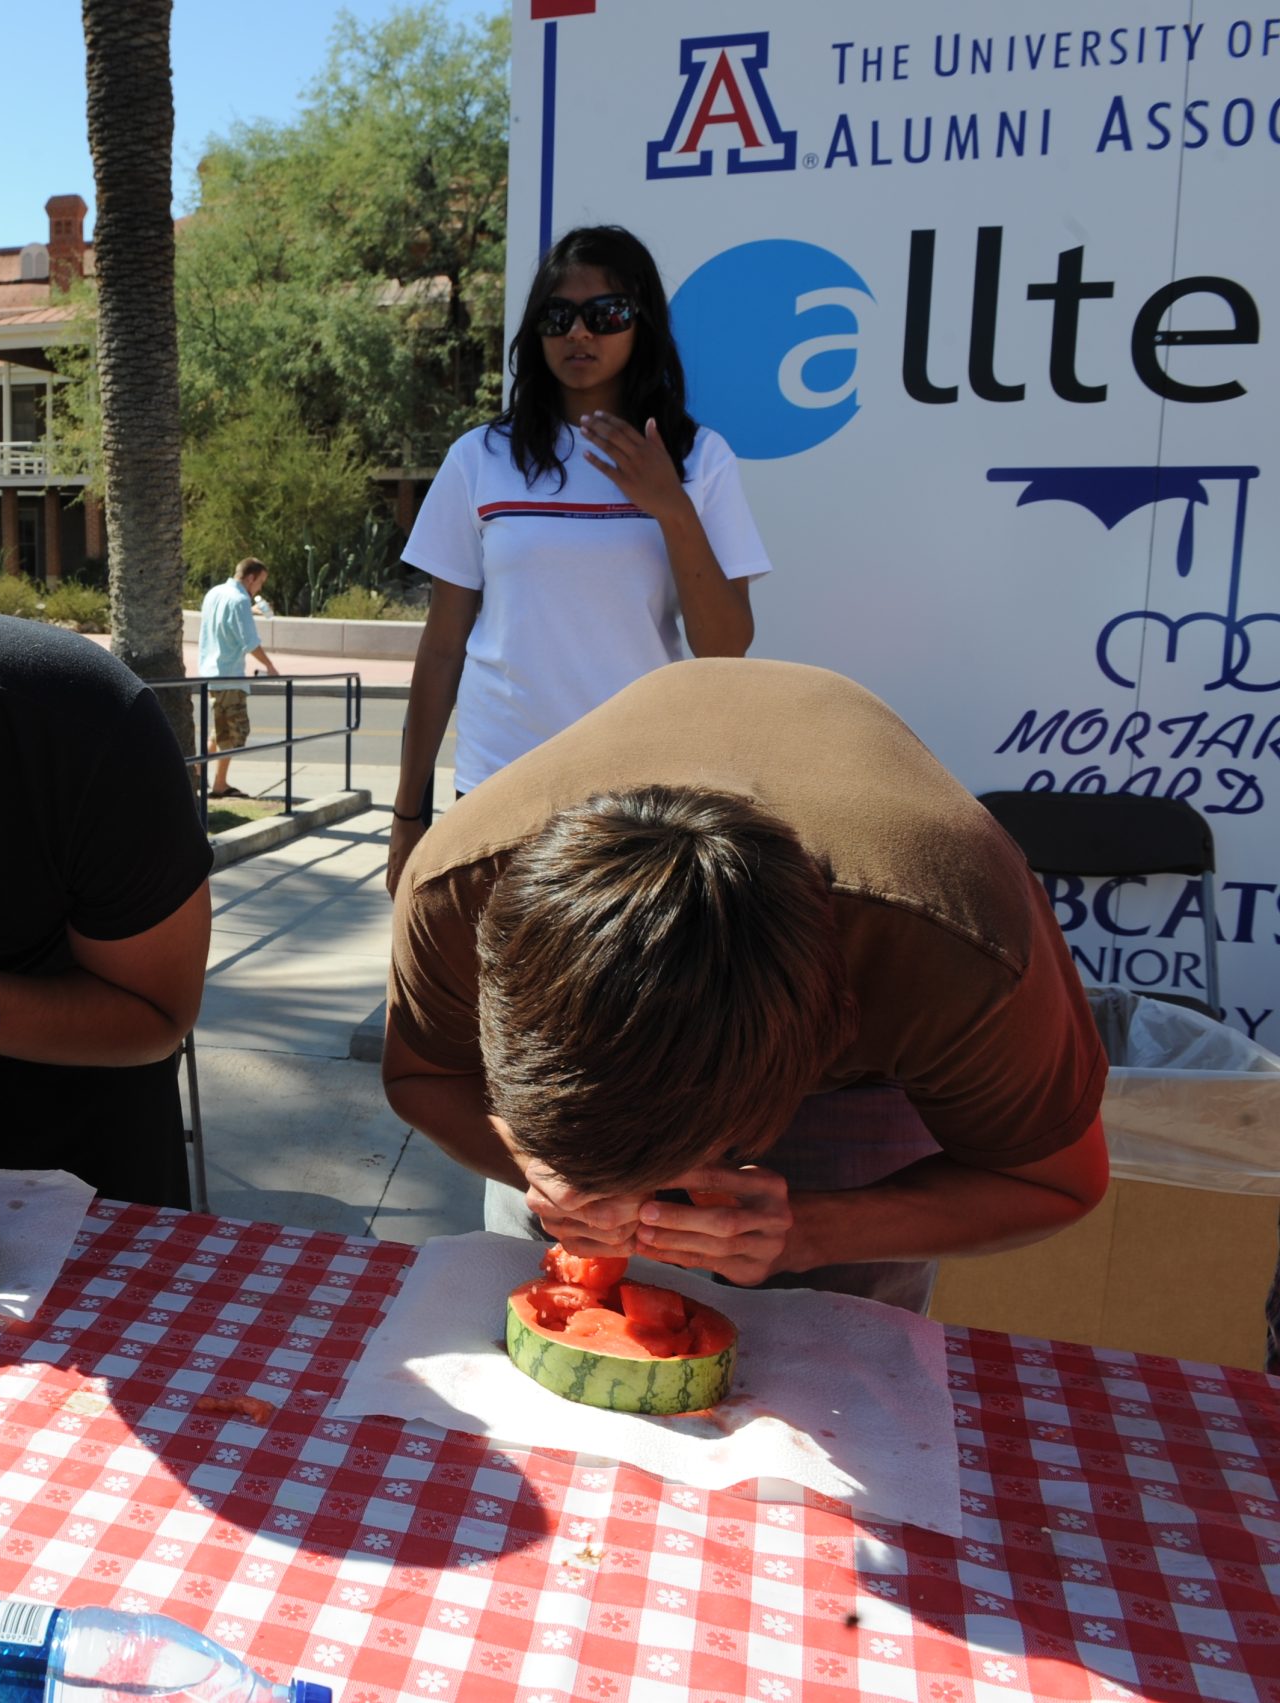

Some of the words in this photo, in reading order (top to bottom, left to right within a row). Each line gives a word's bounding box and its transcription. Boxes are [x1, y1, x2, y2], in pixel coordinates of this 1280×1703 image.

[831, 42, 910, 84] THE
[933, 22, 1205, 78] UNIVERSITY
[1227, 18, 1280, 59] OF
[824, 108, 1051, 169] ALUMNI
[994, 708, 1280, 759] MORTAR
[1042, 872, 1280, 944] BCAT
